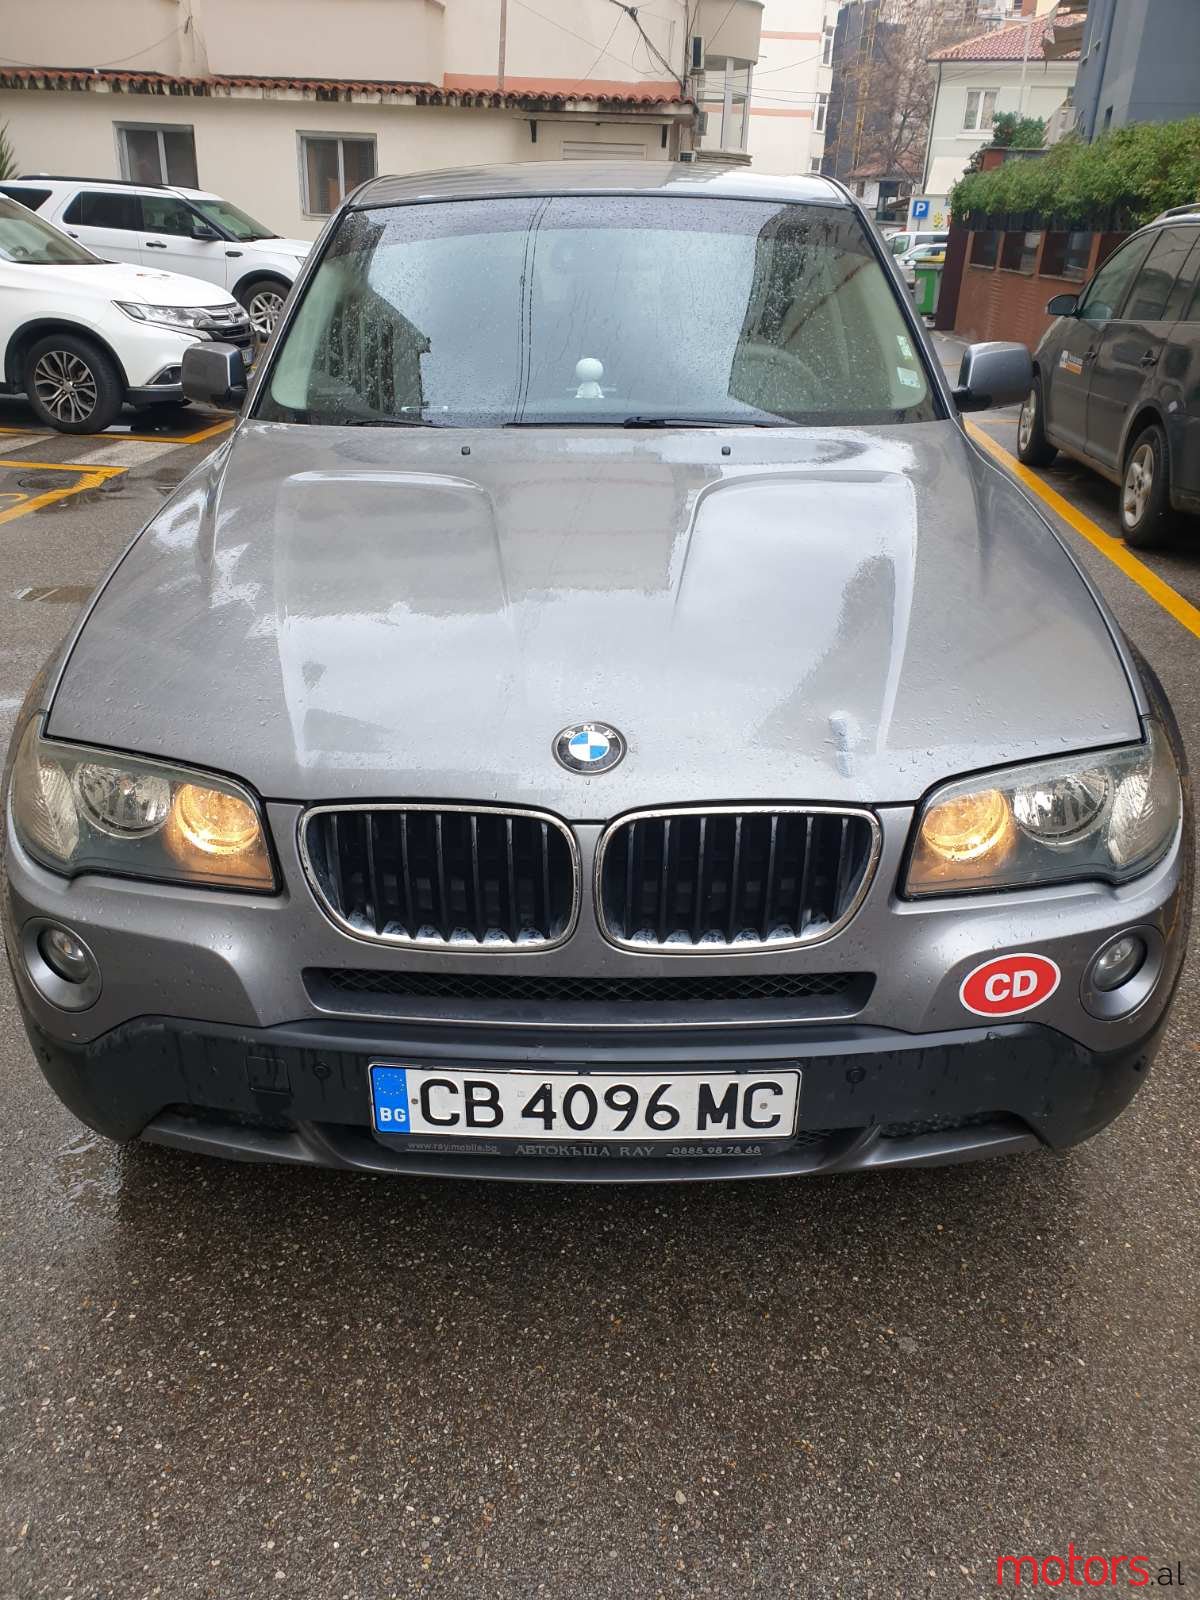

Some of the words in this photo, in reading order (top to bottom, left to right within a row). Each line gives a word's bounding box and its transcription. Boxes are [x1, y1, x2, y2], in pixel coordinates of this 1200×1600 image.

[916, 202, 926, 216] P
[561, 724, 616, 739] BMW
[984, 969, 1038, 1002] CD
[419, 1078, 504, 1128] CB
[521, 1082, 680, 1131] 4096
[696, 1081, 783, 1129] MC
[379, 1107, 407, 1122] BG
[620, 1146, 655, 1156] RAY
